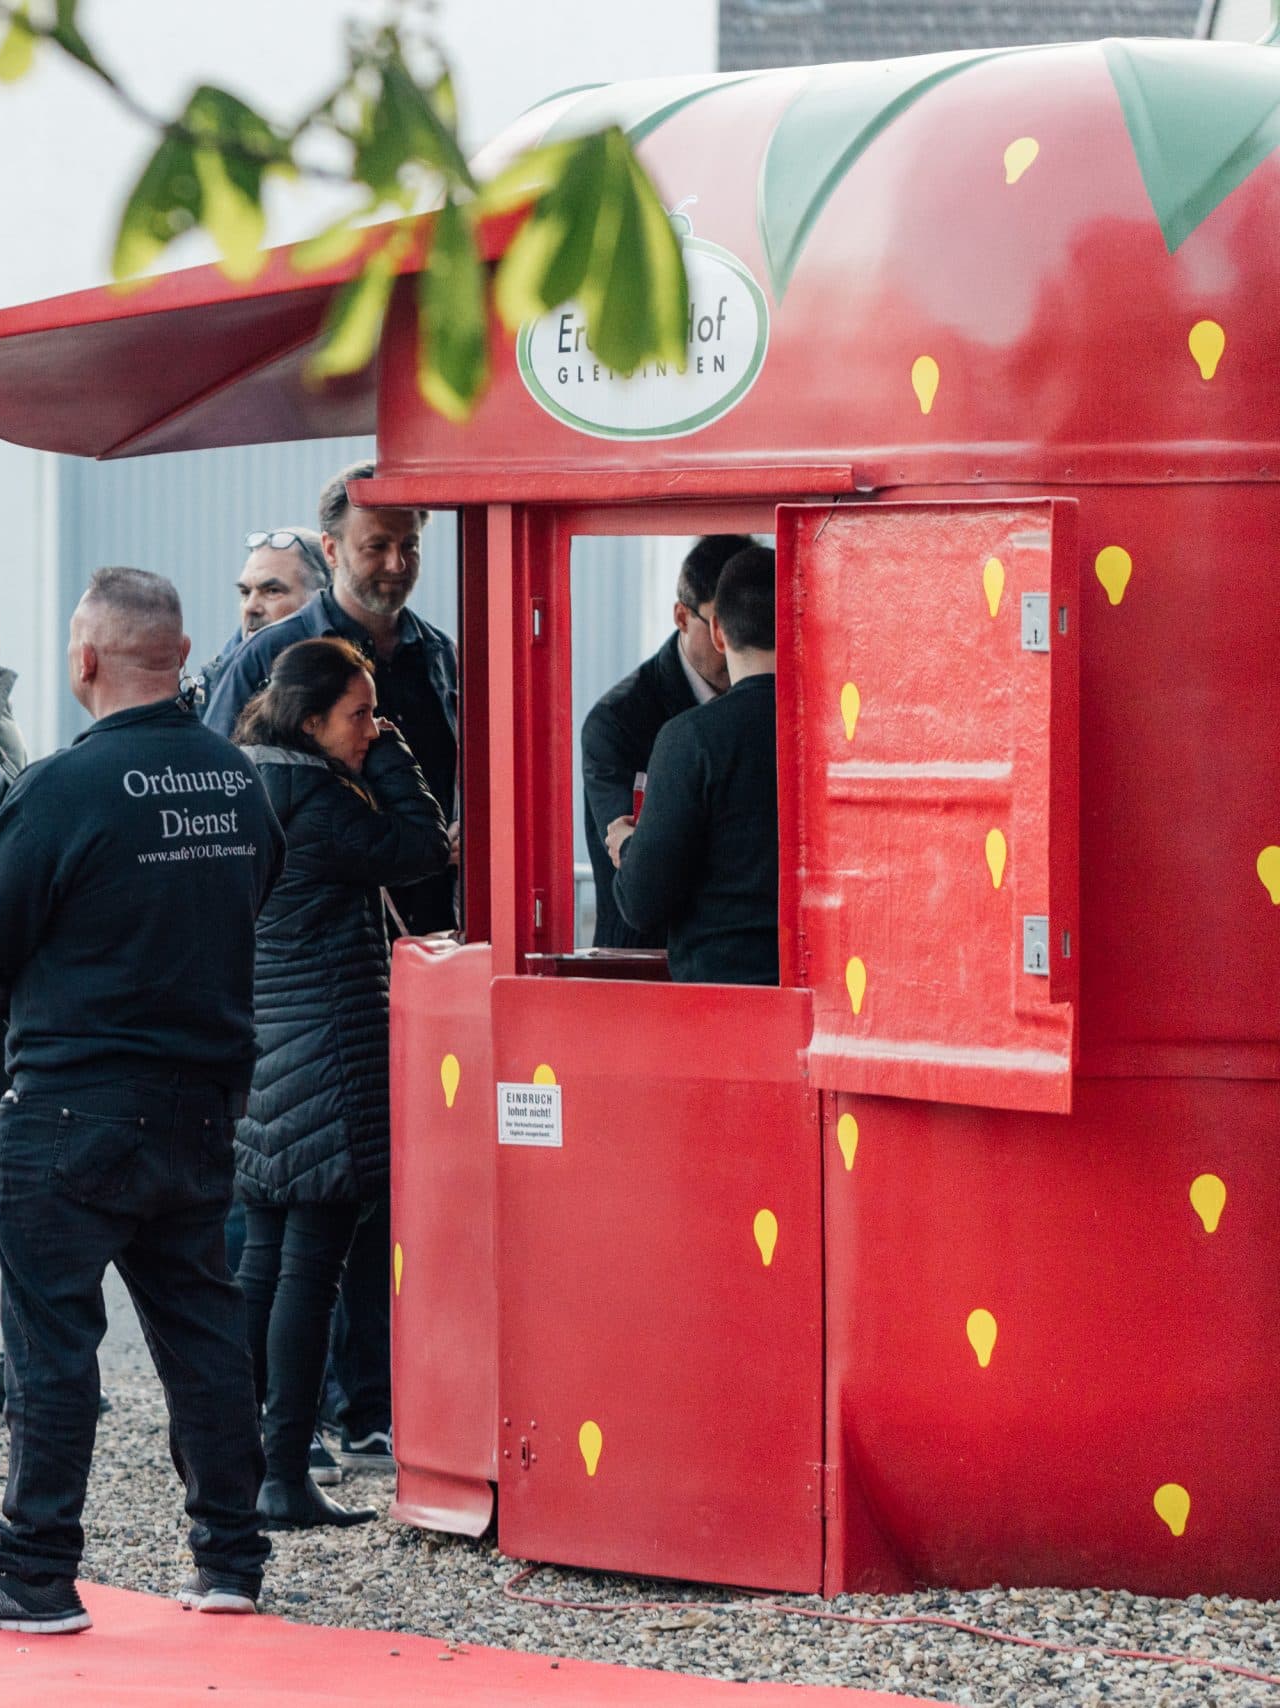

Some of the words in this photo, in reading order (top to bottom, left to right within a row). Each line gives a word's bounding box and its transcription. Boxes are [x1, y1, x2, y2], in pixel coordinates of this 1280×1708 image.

[123, 765, 253, 797] Ordnungs-
[159, 808, 239, 838] Dienst
[138, 843, 257, 864] www.safeYOURevent.de
[506, 1092, 552, 1105] EINBRUCH
[508, 1106, 527, 1117] lohnt
[530, 1107, 551, 1118] nicht!
